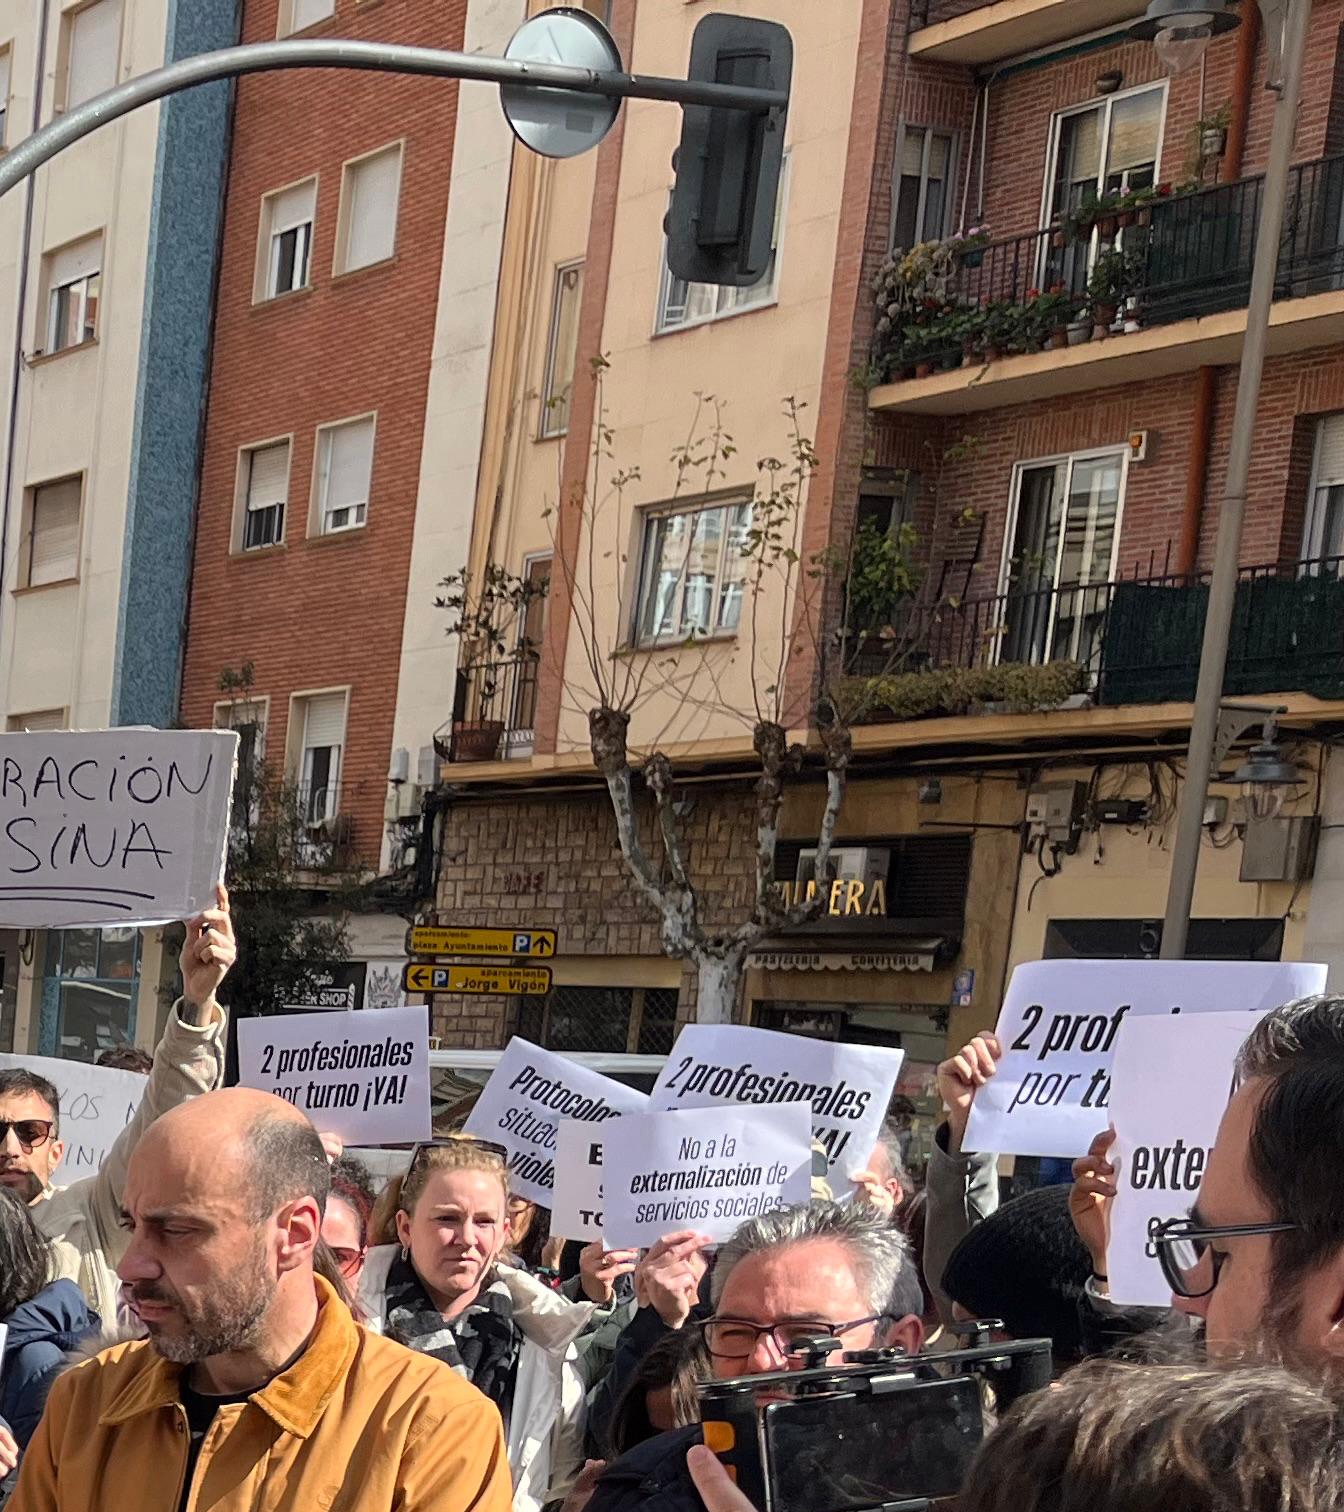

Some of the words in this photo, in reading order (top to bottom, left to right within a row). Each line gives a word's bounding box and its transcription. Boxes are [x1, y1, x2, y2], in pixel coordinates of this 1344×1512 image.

[444, 941, 509, 951] Ayuntamiento
[463, 977, 499, 991] Jorge
[1008, 1005, 1043, 1051] 2
[261, 1045, 274, 1074] 2
[276, 1036, 414, 1079] profesionales
[665, 1056, 694, 1089] 2
[305, 1081, 360, 1109] turno
[362, 1075, 408, 1111] ¡YA!
[509, 1065, 623, 1122] Protocolo
[677, 1063, 872, 1120] profesionales
[1007, 1072, 1082, 1114] por
[498, 1106, 559, 1151] situac
[678, 1136, 701, 1160] No
[704, 1143, 716, 1159] a
[722, 1134, 737, 1157] la
[630, 1163, 763, 1195] externalización
[766, 1161, 789, 1185] de
[635, 1198, 710, 1225] servicios
